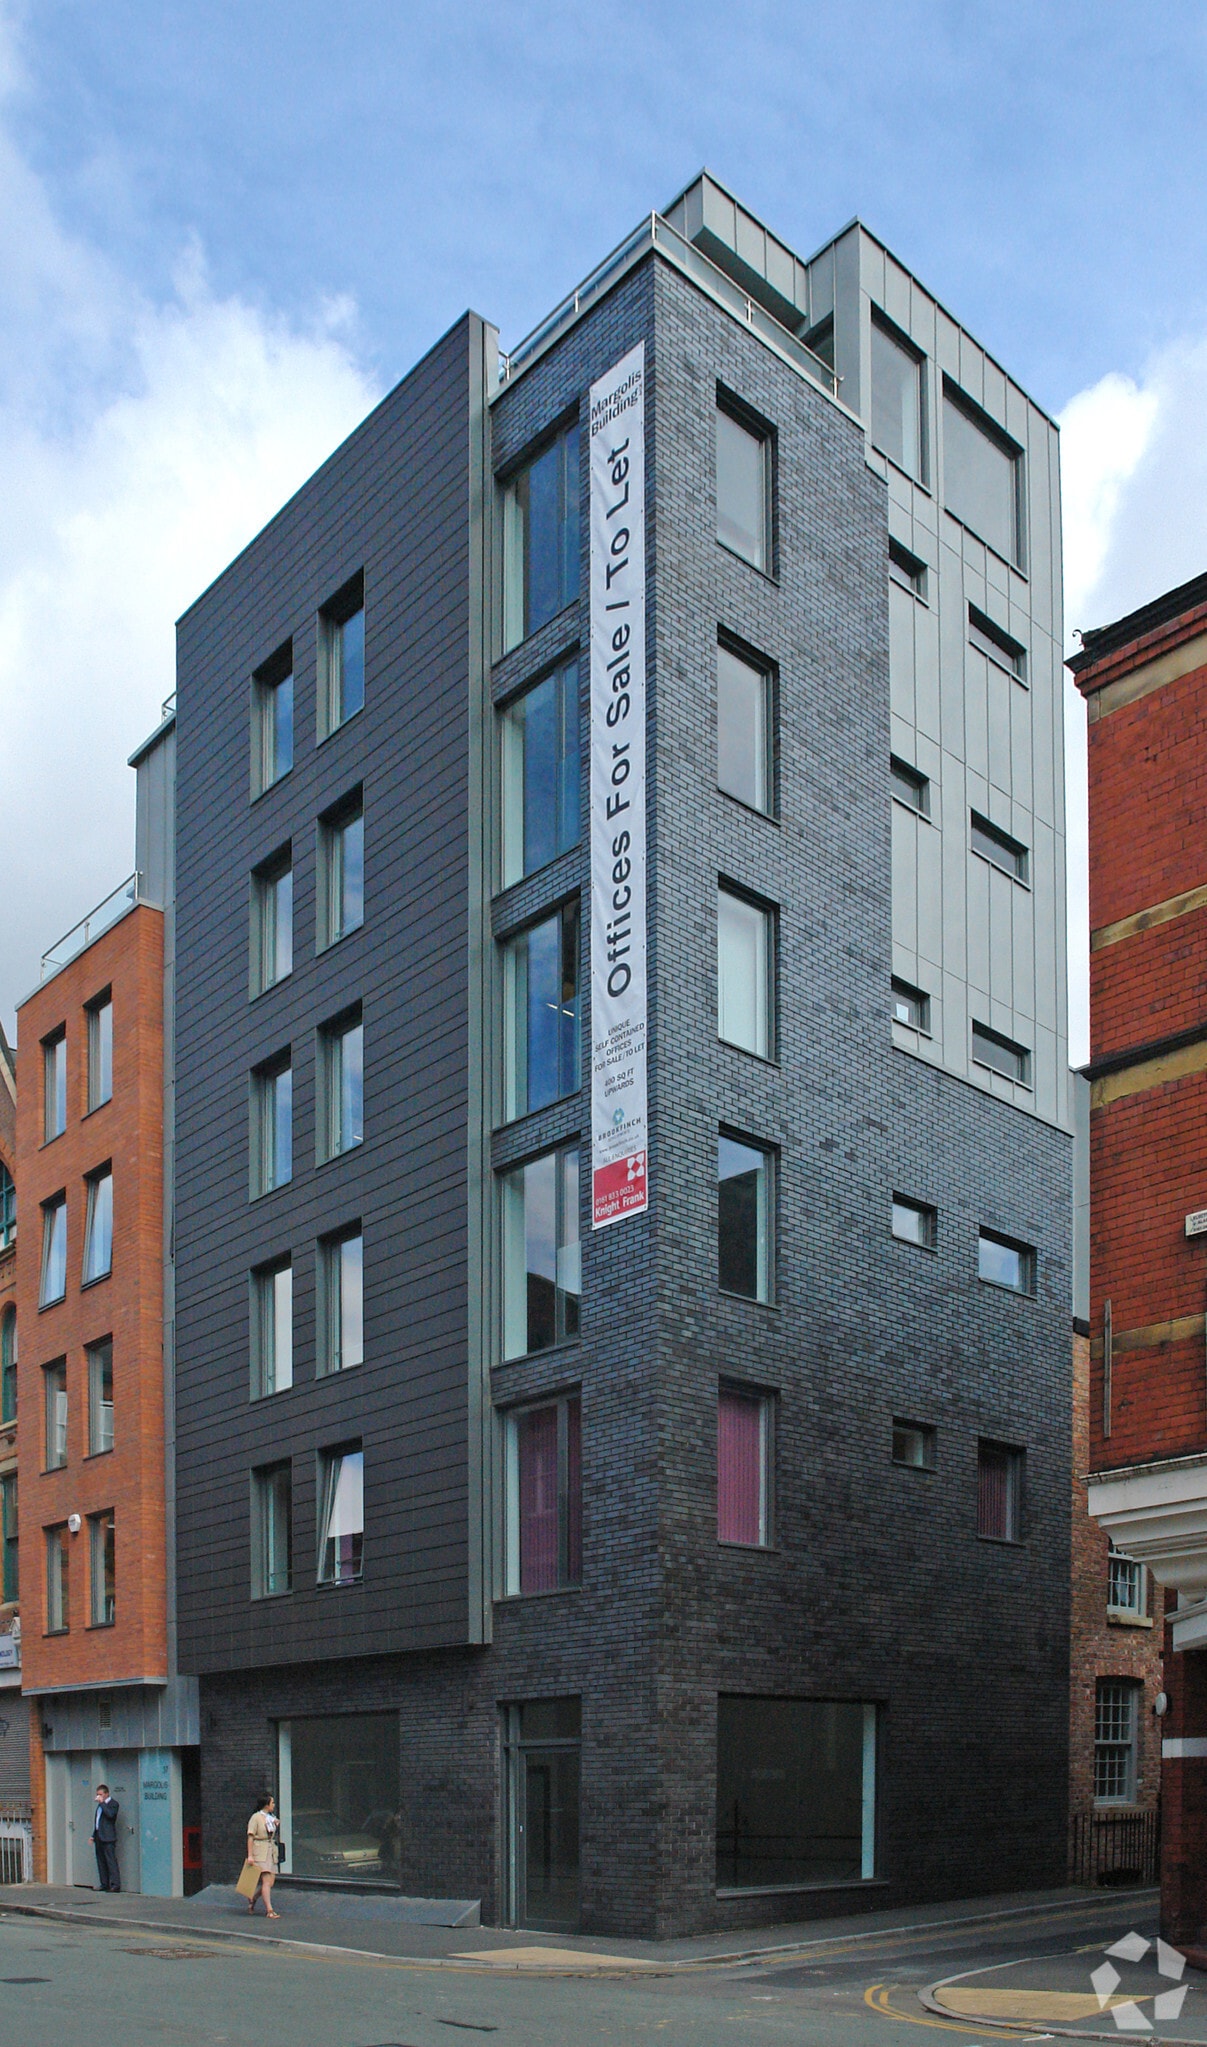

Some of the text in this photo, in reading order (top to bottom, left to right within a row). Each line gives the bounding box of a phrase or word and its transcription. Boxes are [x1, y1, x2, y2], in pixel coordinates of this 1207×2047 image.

[591, 370, 641, 421] Margolis
[591, 388, 638, 437] Building
[606, 437, 630, 520] Let
[606, 527, 630, 590] To
[606, 622, 630, 728] Sale
[607, 743, 630, 821] For
[607, 830, 631, 998] Offices
[595, 1022, 645, 1052] SELF CONTAINED
[608, 1018, 631, 1036] UNIQUE
[594, 1061, 606, 1072] FOR
[634, 1042, 645, 1053] LET
[606, 1039, 632, 1056] OFFICES
[604, 1078, 634, 1097] UPWARDS
[616, 1072, 626, 1081] SQ
[627, 1067, 634, 1076] FT
[598, 1117, 641, 1141] BROOKFINCH
[595, 1190, 645, 1218] Knight Frank
[144, 1792, 167, 1801] BUILDING
